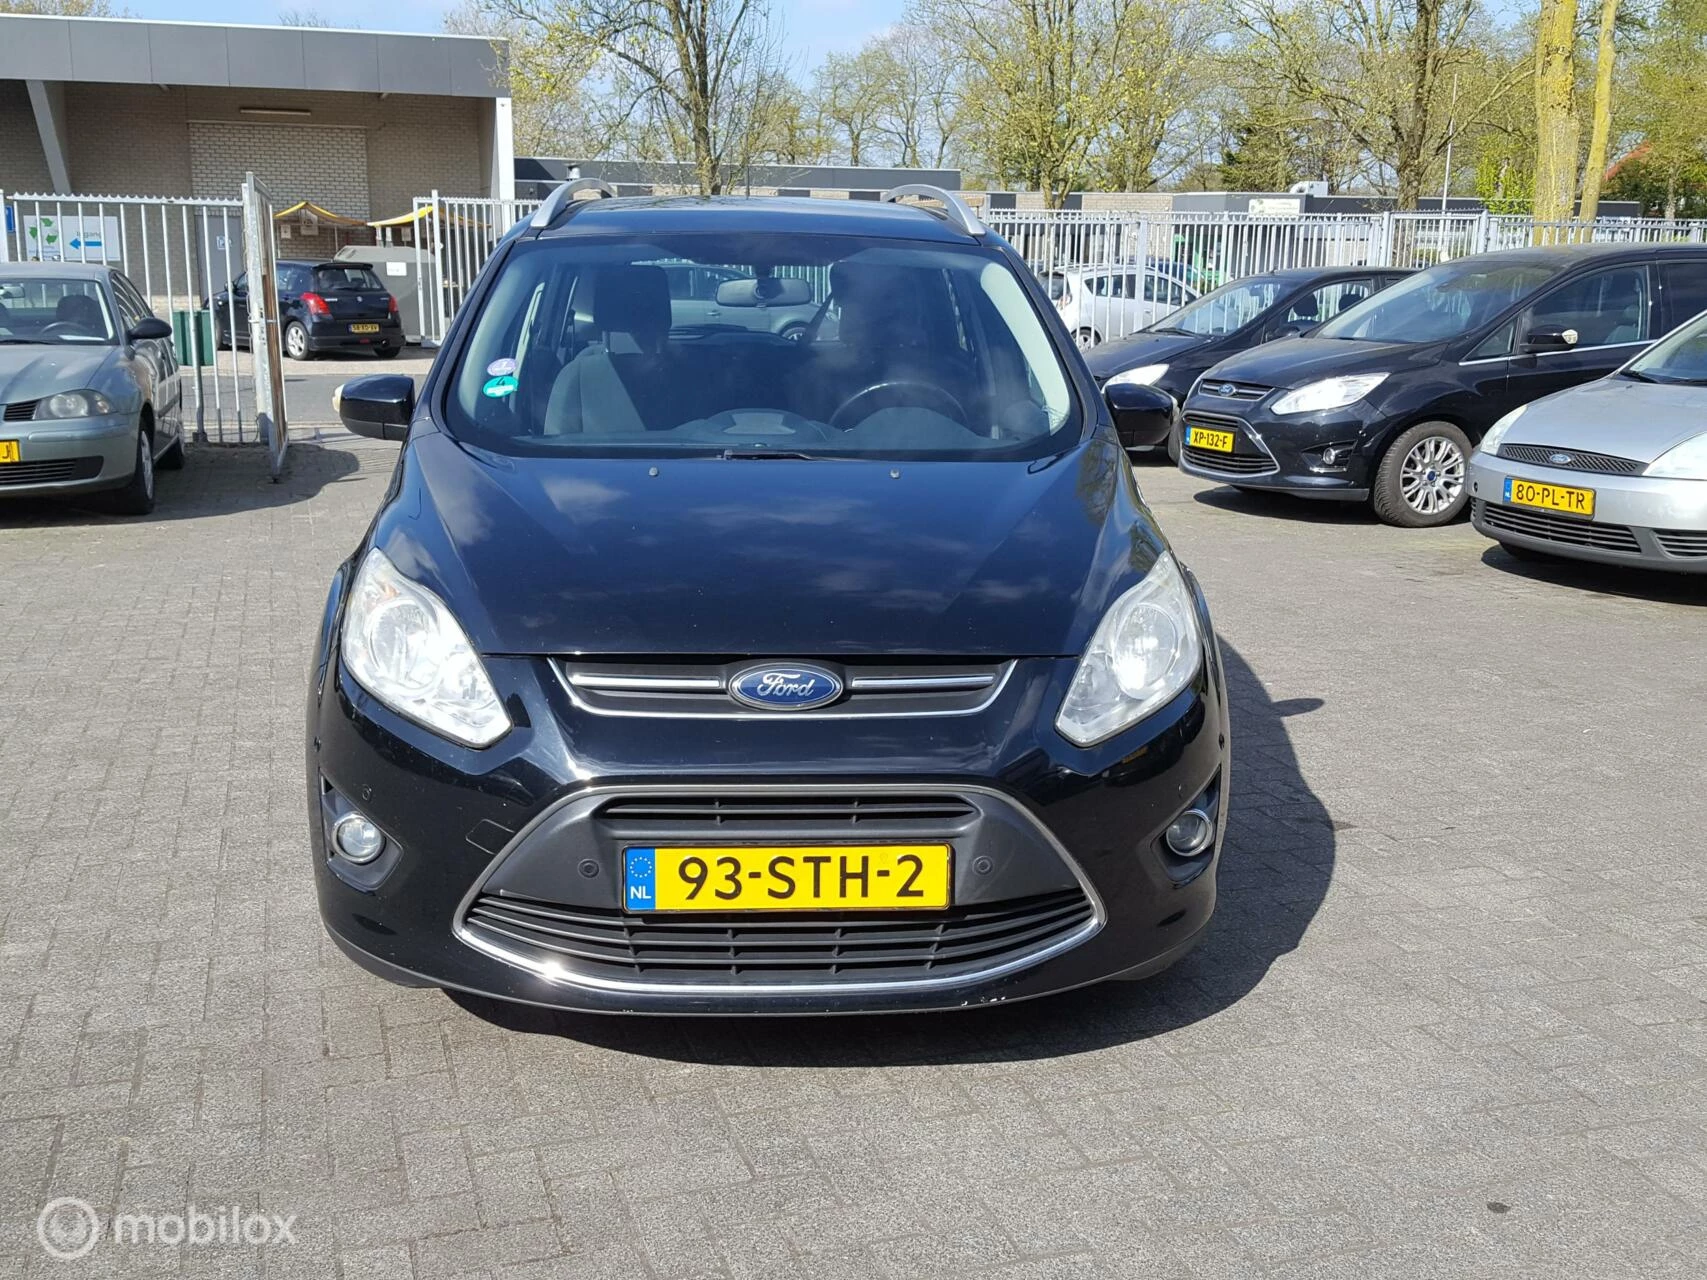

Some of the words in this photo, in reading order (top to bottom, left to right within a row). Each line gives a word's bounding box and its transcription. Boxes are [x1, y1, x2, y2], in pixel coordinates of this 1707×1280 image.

[496, 376, 506, 386] 4
[1193, 430, 1228, 448] XP-132-F
[1516, 483, 1585, 510] 80-PL-TR
[756, 672, 815, 696] Ford
[630, 887, 652, 900] NL
[677, 854, 925, 901] 93-STH-2
